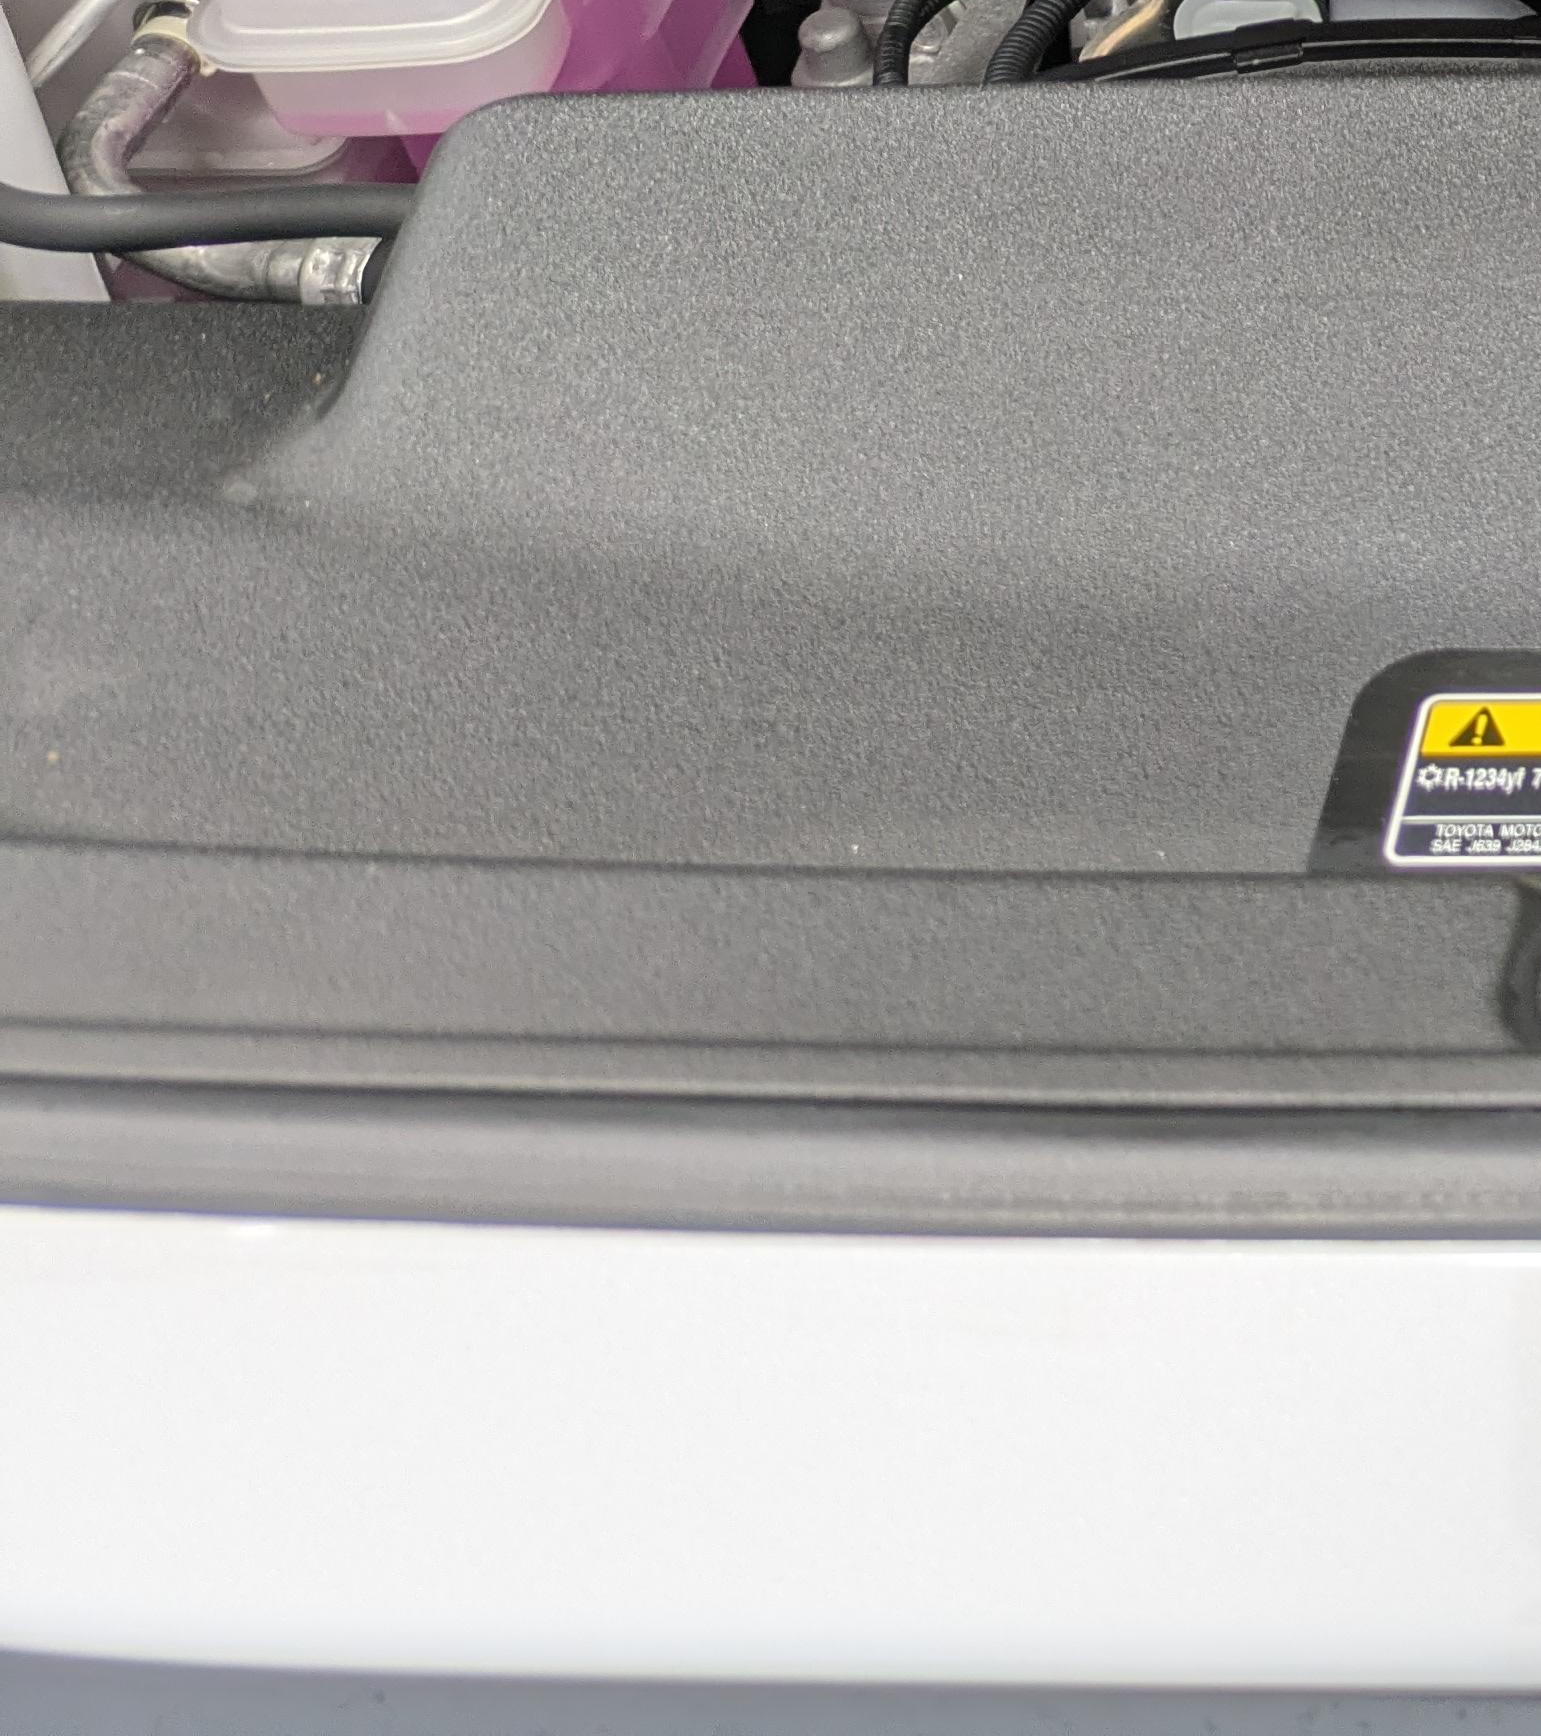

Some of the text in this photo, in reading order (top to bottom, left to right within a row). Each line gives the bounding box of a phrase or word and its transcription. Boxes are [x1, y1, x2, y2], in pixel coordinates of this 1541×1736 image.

[1443, 766, 1527, 795] R-1234yf
[1435, 823, 1496, 839] TOYOTA
[1430, 839, 1462, 855] SAE
